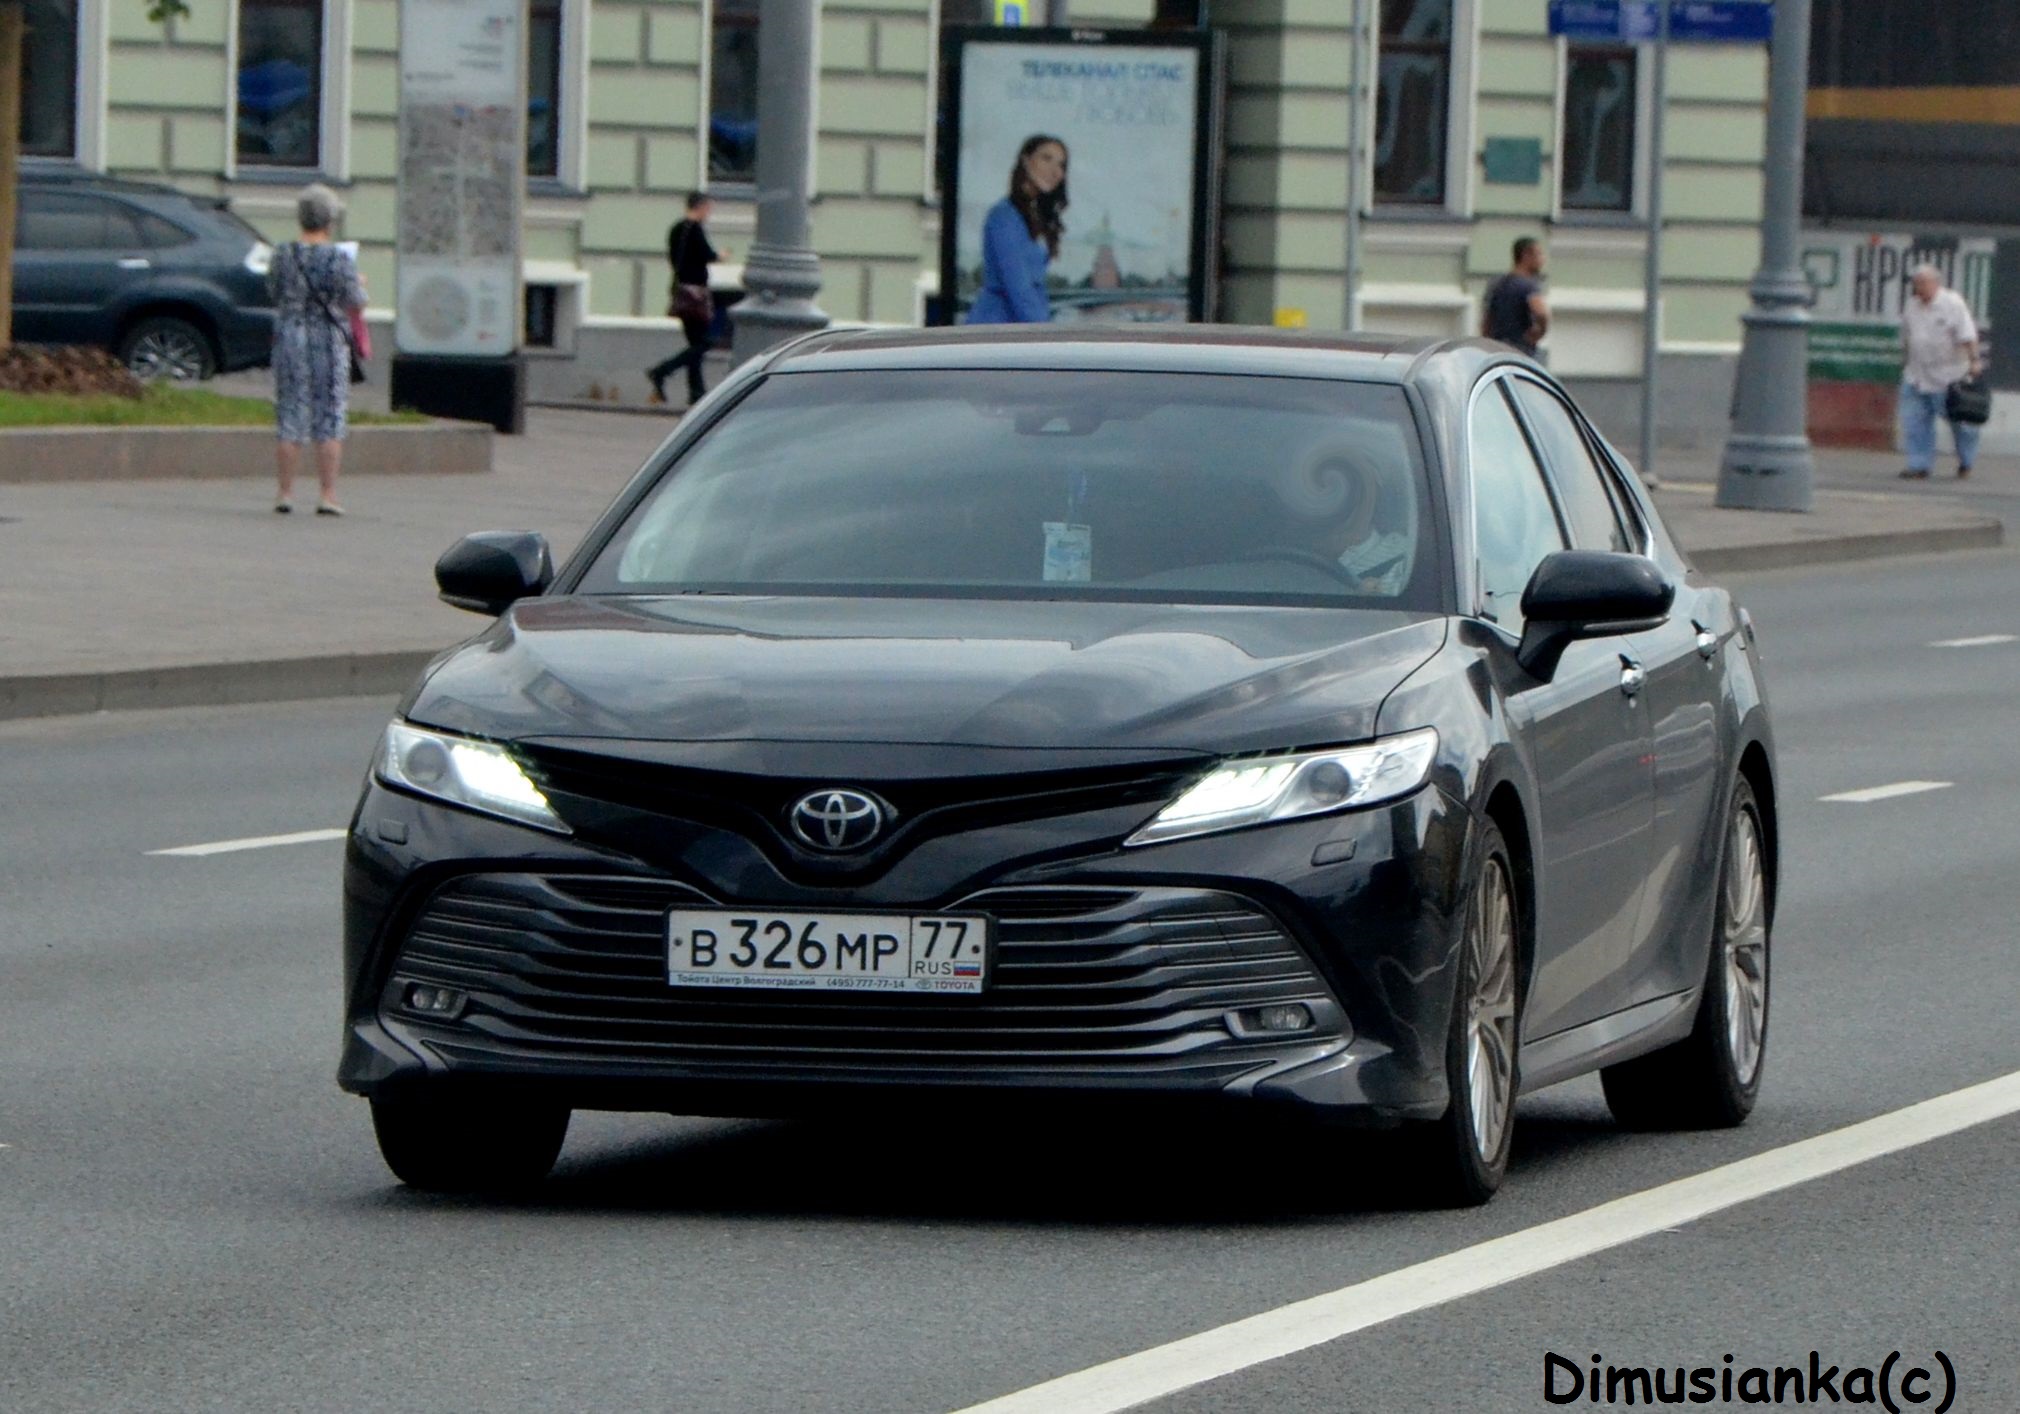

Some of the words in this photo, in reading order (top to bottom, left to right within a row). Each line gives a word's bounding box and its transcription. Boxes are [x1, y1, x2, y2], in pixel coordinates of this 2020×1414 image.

[919, 920, 968, 958] 77
[914, 960, 952, 976] RUS
[677, 973, 710, 984] Тойота
[712, 975, 742, 986] Центр
[826, 978, 854, 988] (495)
[934, 980, 976, 990] TOYOTA
